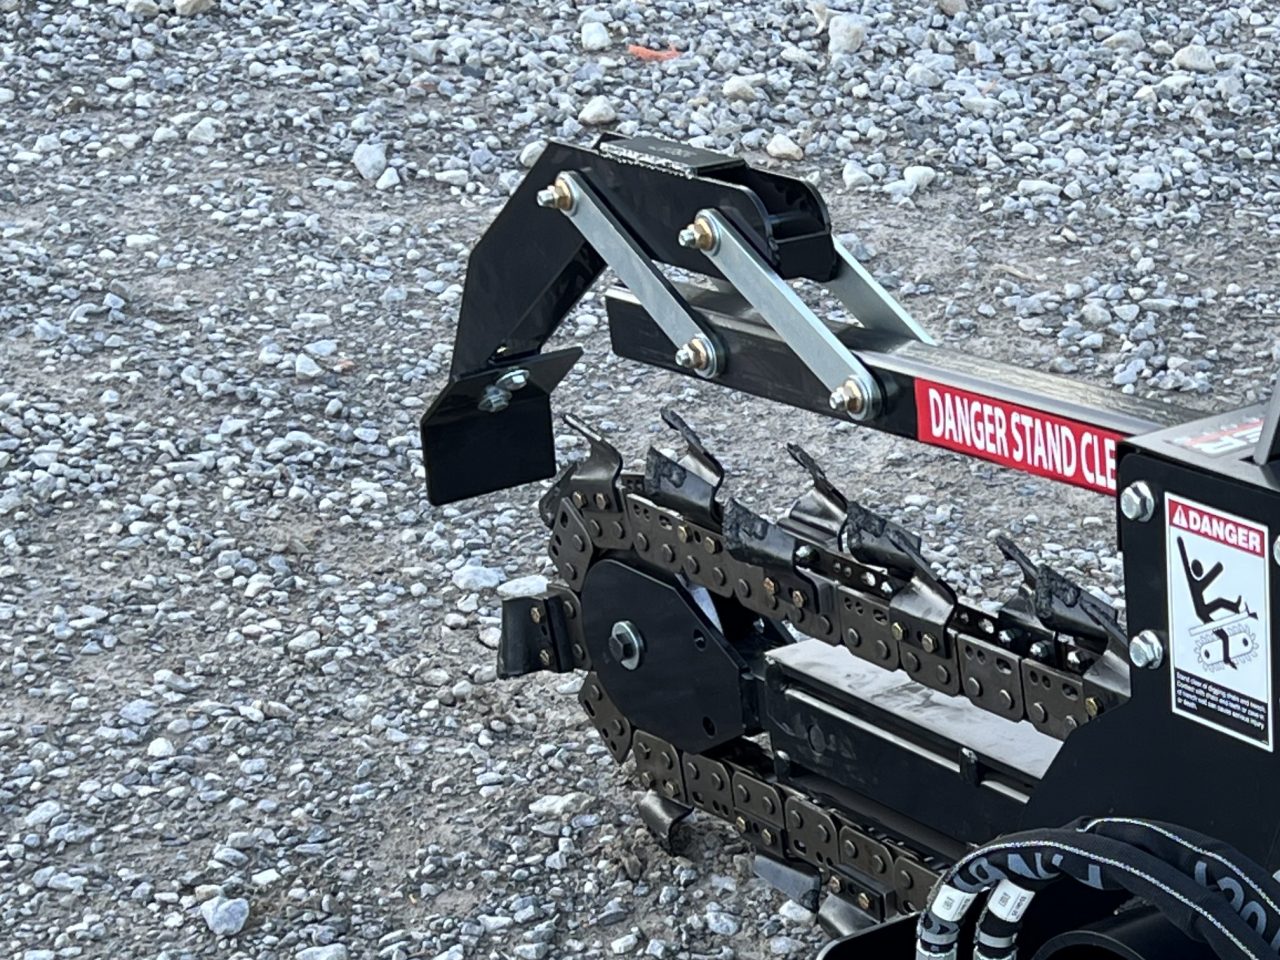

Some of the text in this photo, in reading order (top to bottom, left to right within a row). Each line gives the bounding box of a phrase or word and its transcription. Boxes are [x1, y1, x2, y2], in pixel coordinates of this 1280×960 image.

[928, 388, 1009, 458] DANGER
[1011, 411, 1077, 477] STAND
[1080, 432, 1117, 490] CLE
[1188, 509, 1262, 552] DANGER
